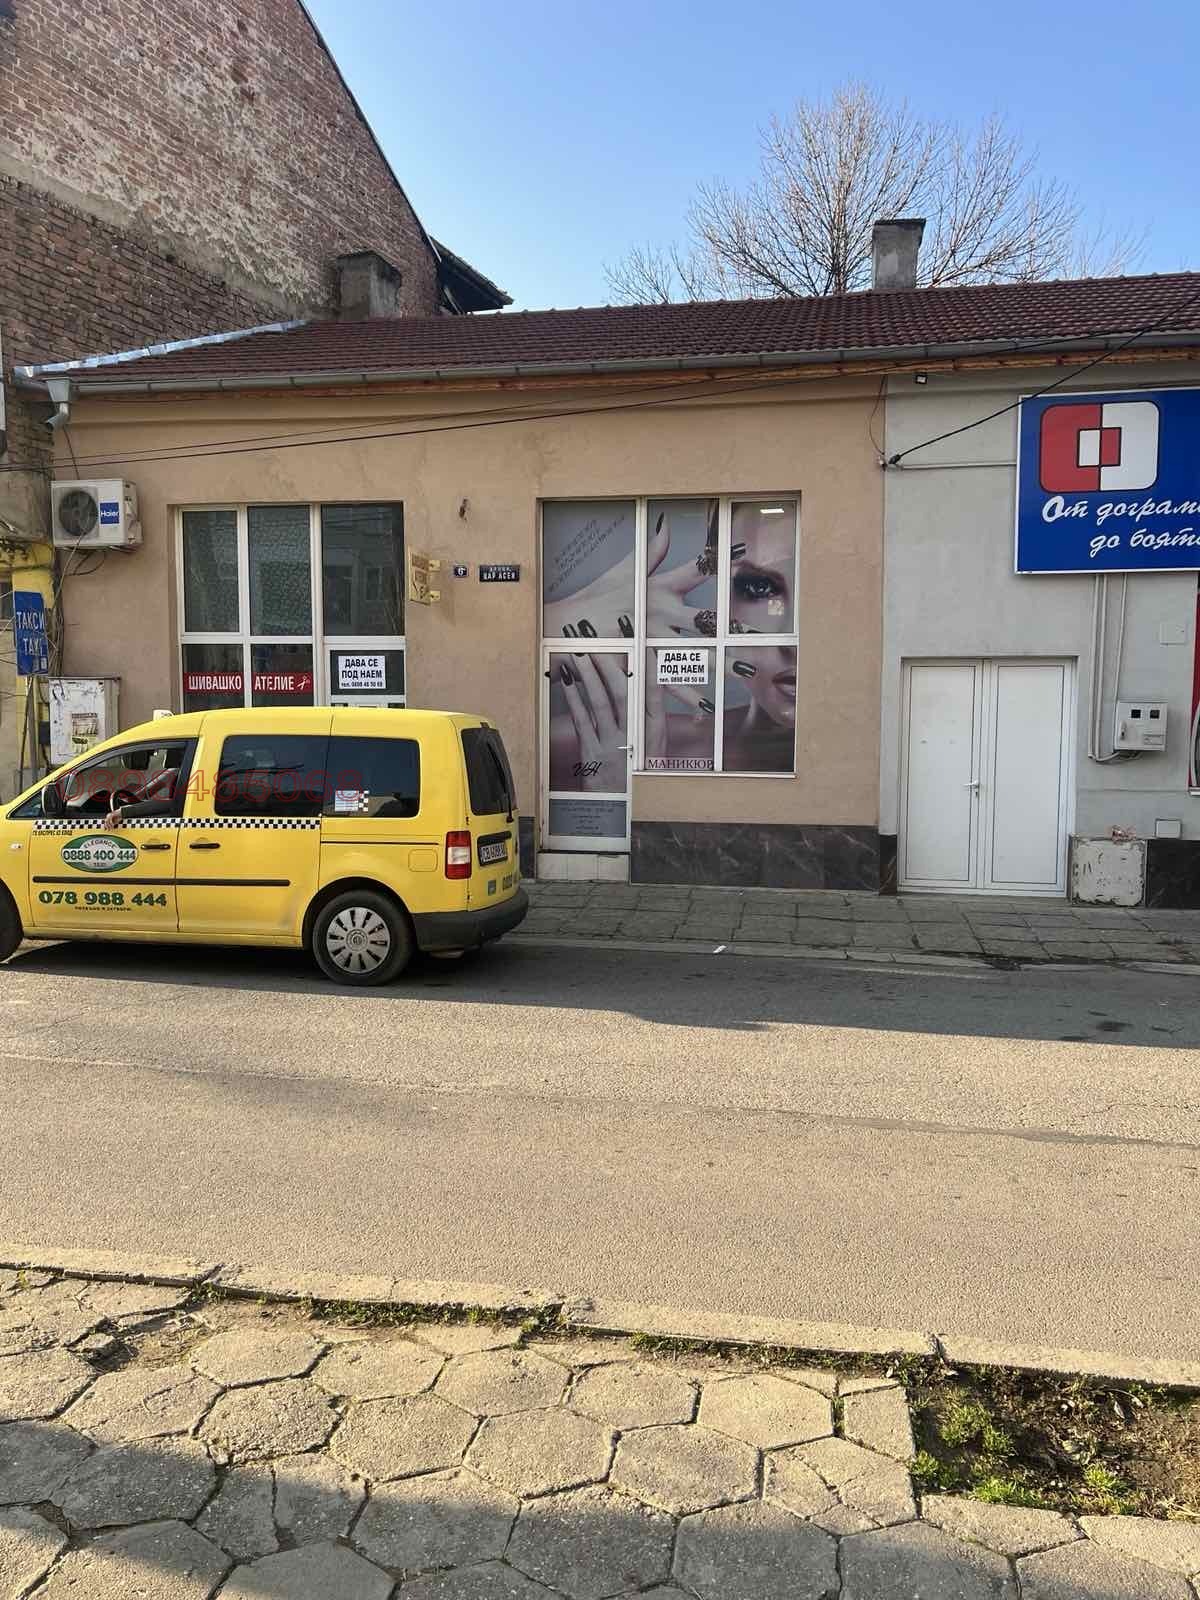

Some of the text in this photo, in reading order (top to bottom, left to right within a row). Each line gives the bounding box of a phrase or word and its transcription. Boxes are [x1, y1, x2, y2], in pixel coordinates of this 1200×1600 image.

[1042, 495, 1088, 523] От
[1089, 534, 1120, 558] до
[16, 611, 45, 630] ТАКСИ
[345, 658, 378, 668] ДАВА СЕ
[664, 652, 701, 663] ДАВА СЕ
[341, 669, 382, 680] ПОД НАЕМ
[660, 664, 704, 674] ПОД НАЕМ
[188, 675, 242, 690] ШИВАШКО
[254, 676, 294, 691] АТЕЛИЕ
[648, 758, 714, 770] МАНИКЮР
[62, 850, 136, 861] 0888 400 444
[38, 890, 167, 907] 078 988 444
